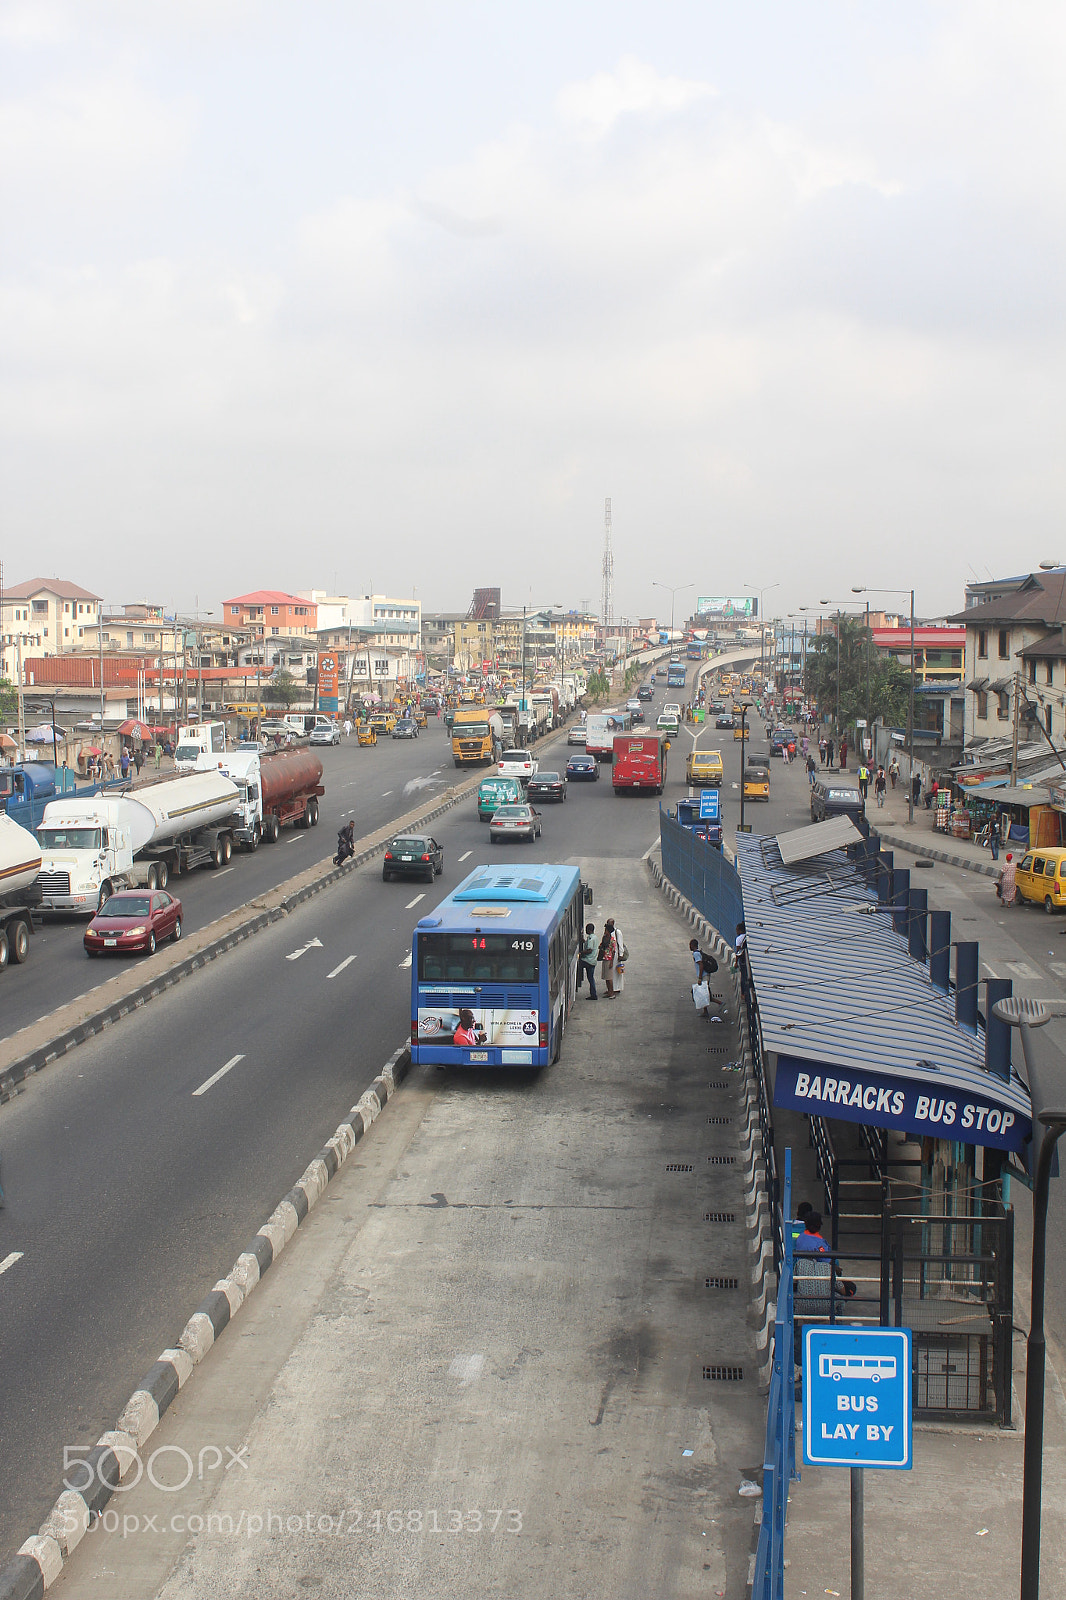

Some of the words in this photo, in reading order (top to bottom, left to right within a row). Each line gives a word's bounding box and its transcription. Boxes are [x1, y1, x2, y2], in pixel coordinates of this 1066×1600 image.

[472, 937, 486, 949] 14
[511, 940, 534, 951] 419
[794, 1072, 905, 1115] BARRACKS
[914, 1095, 957, 1125] BUS
[960, 1104, 1015, 1135] STOP
[837, 1395, 878, 1412] BUS
[821, 1422, 860, 1440] LAY
[866, 1424, 894, 1441] BY
